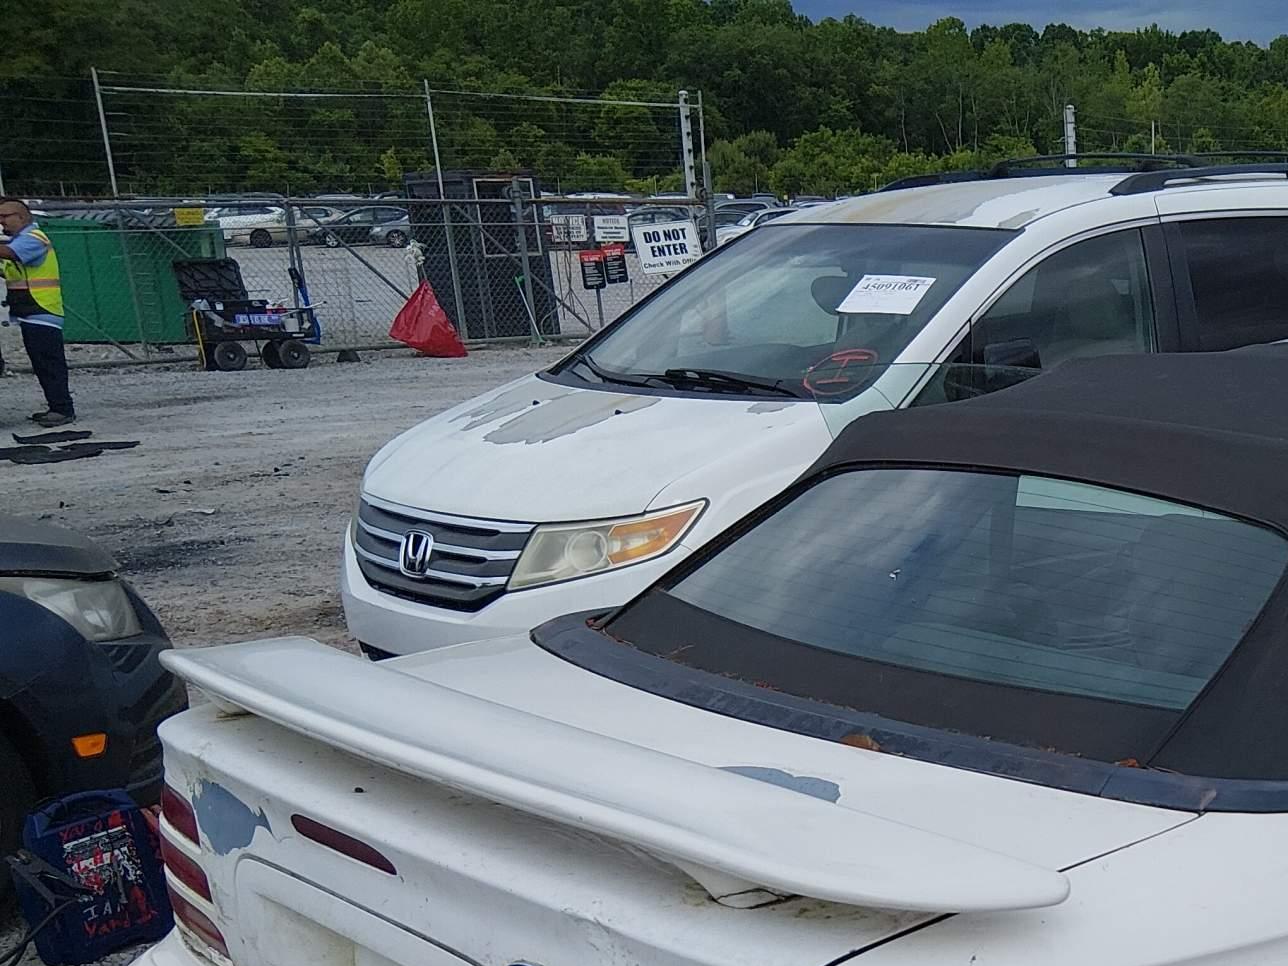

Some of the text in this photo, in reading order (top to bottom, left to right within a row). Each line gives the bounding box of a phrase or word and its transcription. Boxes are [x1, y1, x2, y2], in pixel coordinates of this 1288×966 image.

[642, 230, 661, 244] DO
[662, 228, 687, 242] NOT
[650, 243, 689, 258] ENTER
[643, 261, 664, 269] Check
